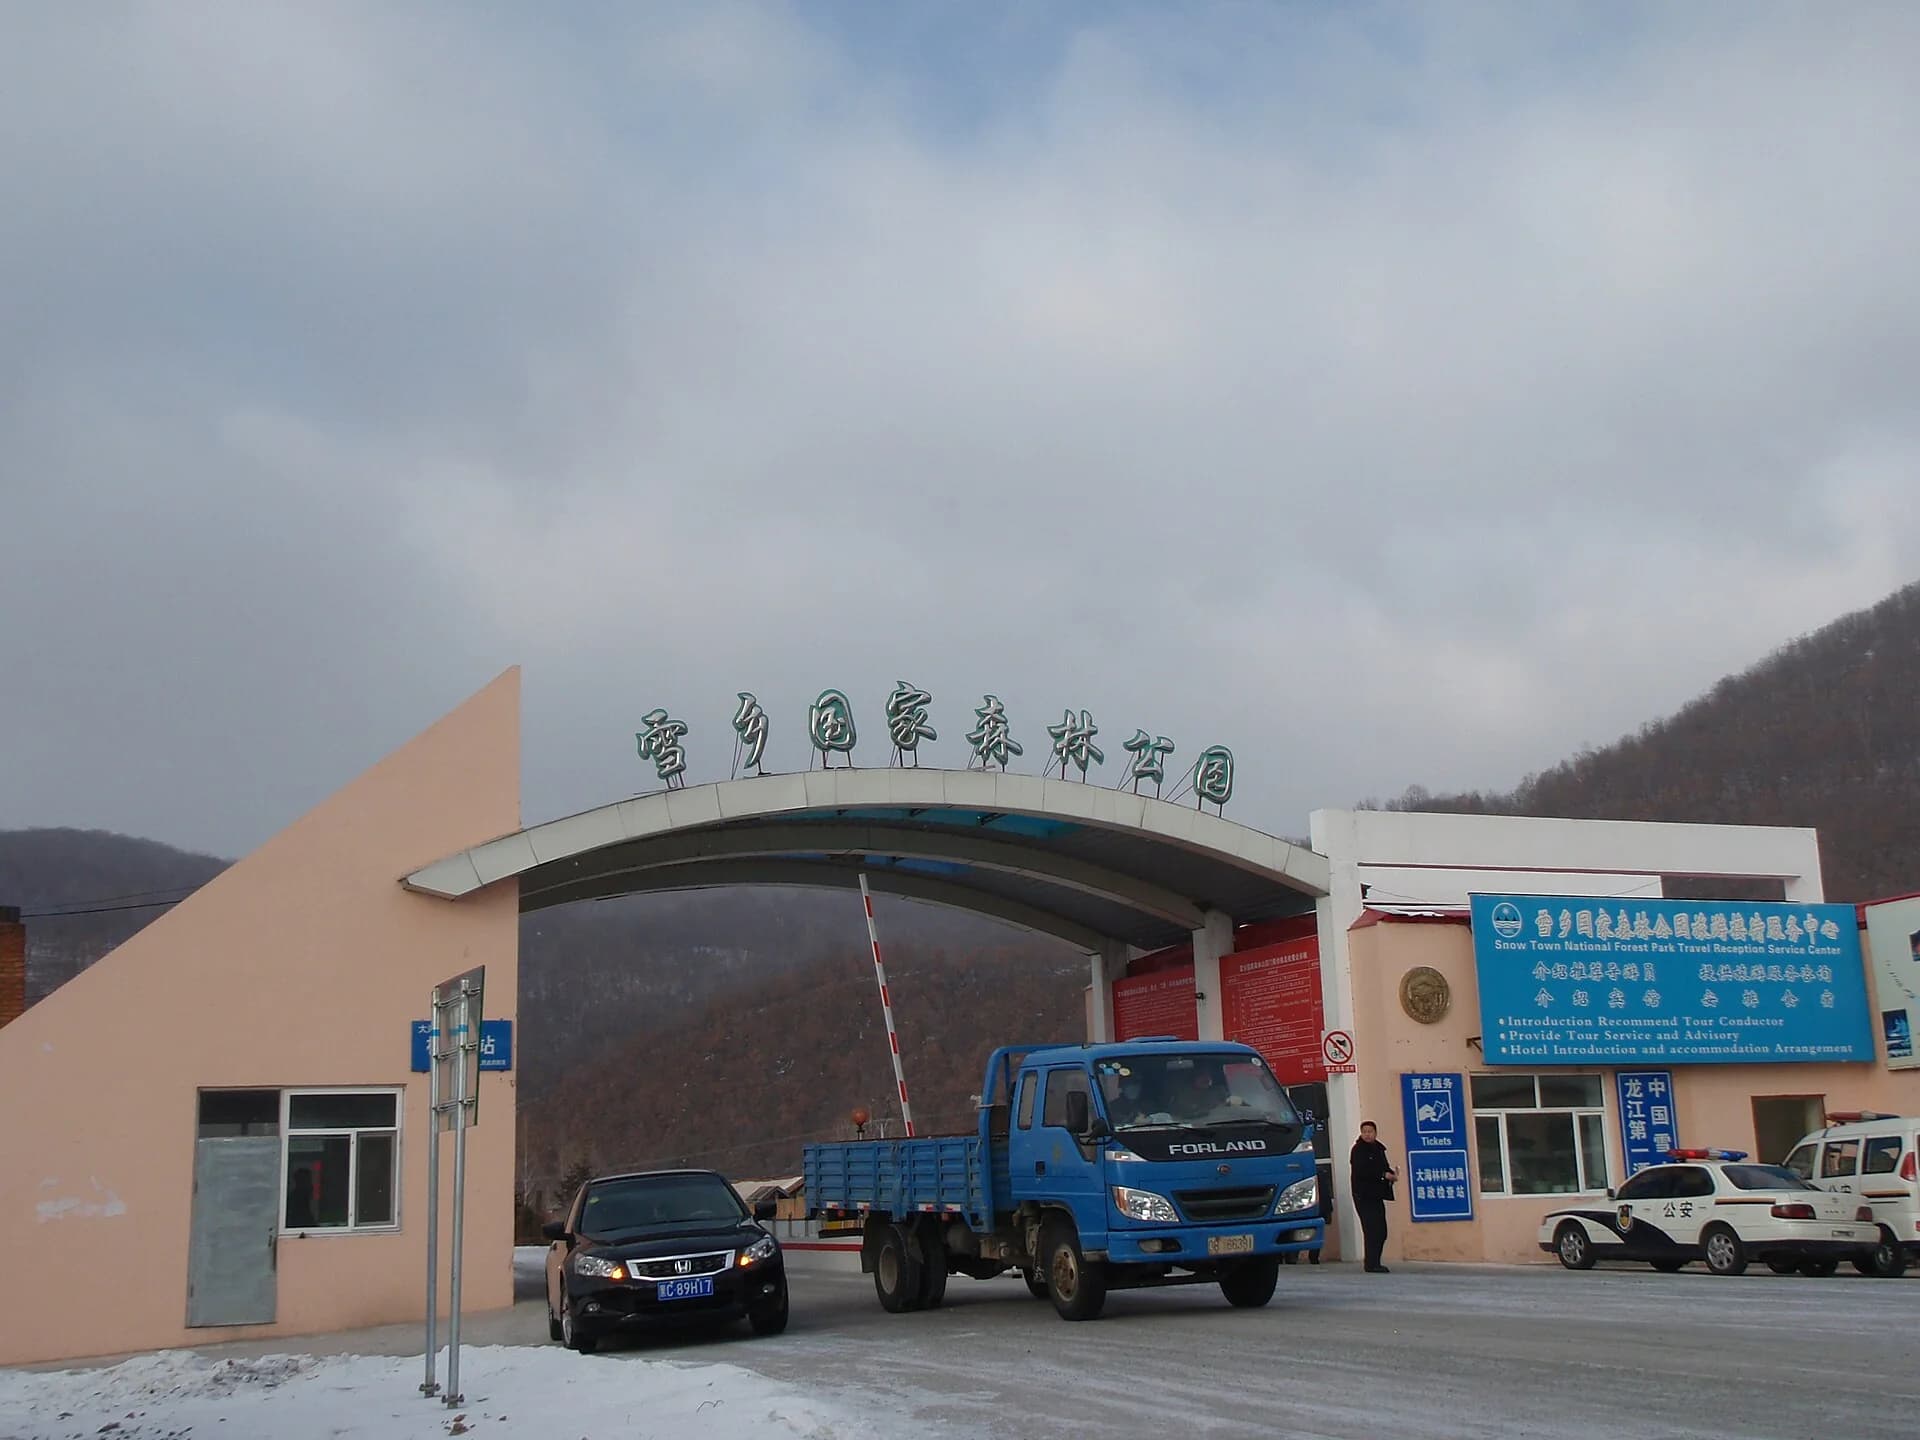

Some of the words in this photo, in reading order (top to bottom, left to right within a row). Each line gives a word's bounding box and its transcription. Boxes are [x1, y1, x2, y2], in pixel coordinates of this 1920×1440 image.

[636, 681, 1234, 805] 雪乡国家森林公园
[1494, 939, 1527, 950] Snow
[1529, 940, 1561, 951] Town
[1564, 941, 1612, 952] National
[1614, 942, 1649, 952] Forest
[1651, 942, 1676, 953] Park
[1677, 943, 1711, 953] Travel
[1713, 943, 1765, 955] Reception
[1767, 944, 1805, 954] Service
[1807, 944, 1841, 955] Center
[1507, 1016, 1593, 1027] Introduction
[1598, 1016, 1678, 1026] Recommend
[1682, 1016, 1713, 1026] Tour
[1718, 1016, 1785, 1026] Conductor
[1509, 1030, 1561, 1041] Provide
[1566, 1030, 1599, 1041] Tour
[1604, 1030, 1651, 1040] Service
[1656, 1030, 1680, 1040] and
[1684, 1030, 1739, 1042] Advisory
[1510, 1045, 1547, 1055] Hotel
[1553, 1044, 1636, 1055] Introduction
[1641, 1044, 1665, 1054] and
[1669, 1043, 1769, 1054] accommodation
[1774, 1043, 1853, 1055] Arrangement
[1411, 1078, 1453, 1090] 票务服务
[1648, 1078, 1672, 1164] 中国雪
[1169, 1139, 1267, 1155] FORLAND
[1421, 1137, 1452, 1146] Tickets
[1662, 1200, 1693, 1218] 公安
